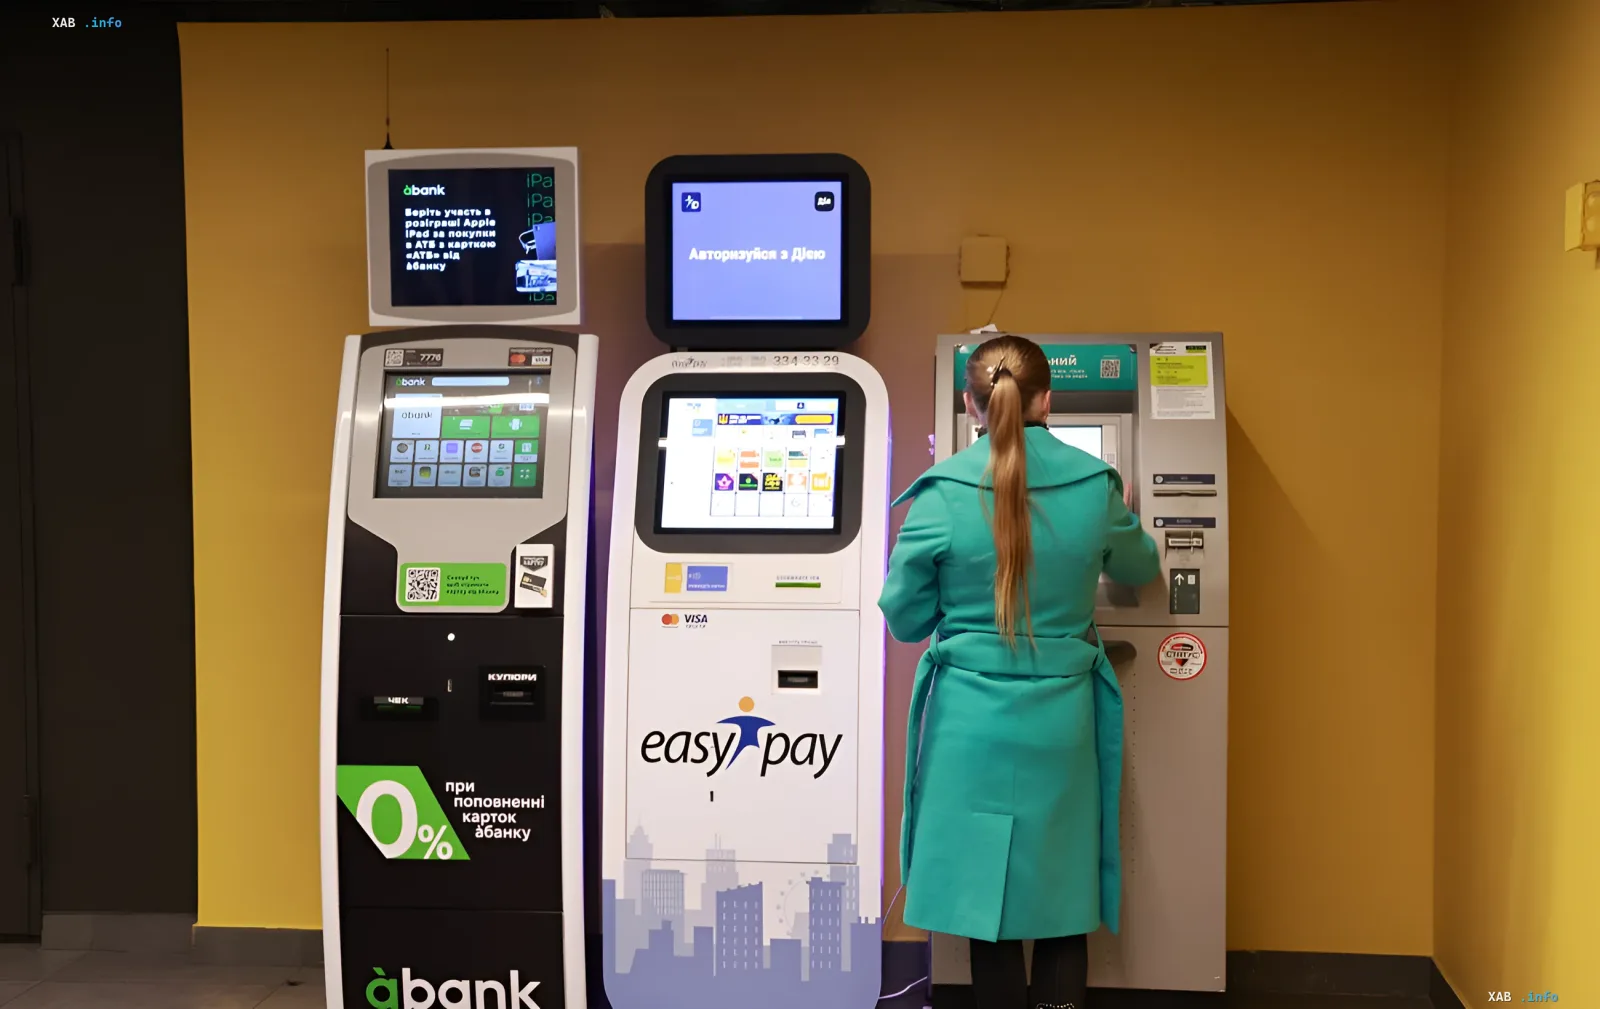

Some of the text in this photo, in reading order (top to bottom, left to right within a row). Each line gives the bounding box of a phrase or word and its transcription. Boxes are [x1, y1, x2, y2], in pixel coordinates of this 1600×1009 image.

[404, 207, 441, 218] Беріть
[444, 208, 482, 218] участь
[405, 217, 496, 229] розіграші Apple
[405, 229, 496, 239] iPad за покупки
[415, 240, 436, 249] АТБ
[447, 241, 496, 250] карткою
[405, 250, 460, 260] «АТБ» від
[688, 247, 778, 263] Авторизуйся
[790, 247, 827, 262] Дією
[773, 355, 798, 366] 334
[823, 355, 840, 366] 29
[684, 614, 708, 624] VISA
[487, 673, 538, 681] КУПЮРИ
[640, 731, 844, 779] easy pay
[445, 781, 475, 795] при
[453, 795, 546, 809] поповненні
[356, 779, 454, 860] 0%
[462, 811, 517, 826] карток
